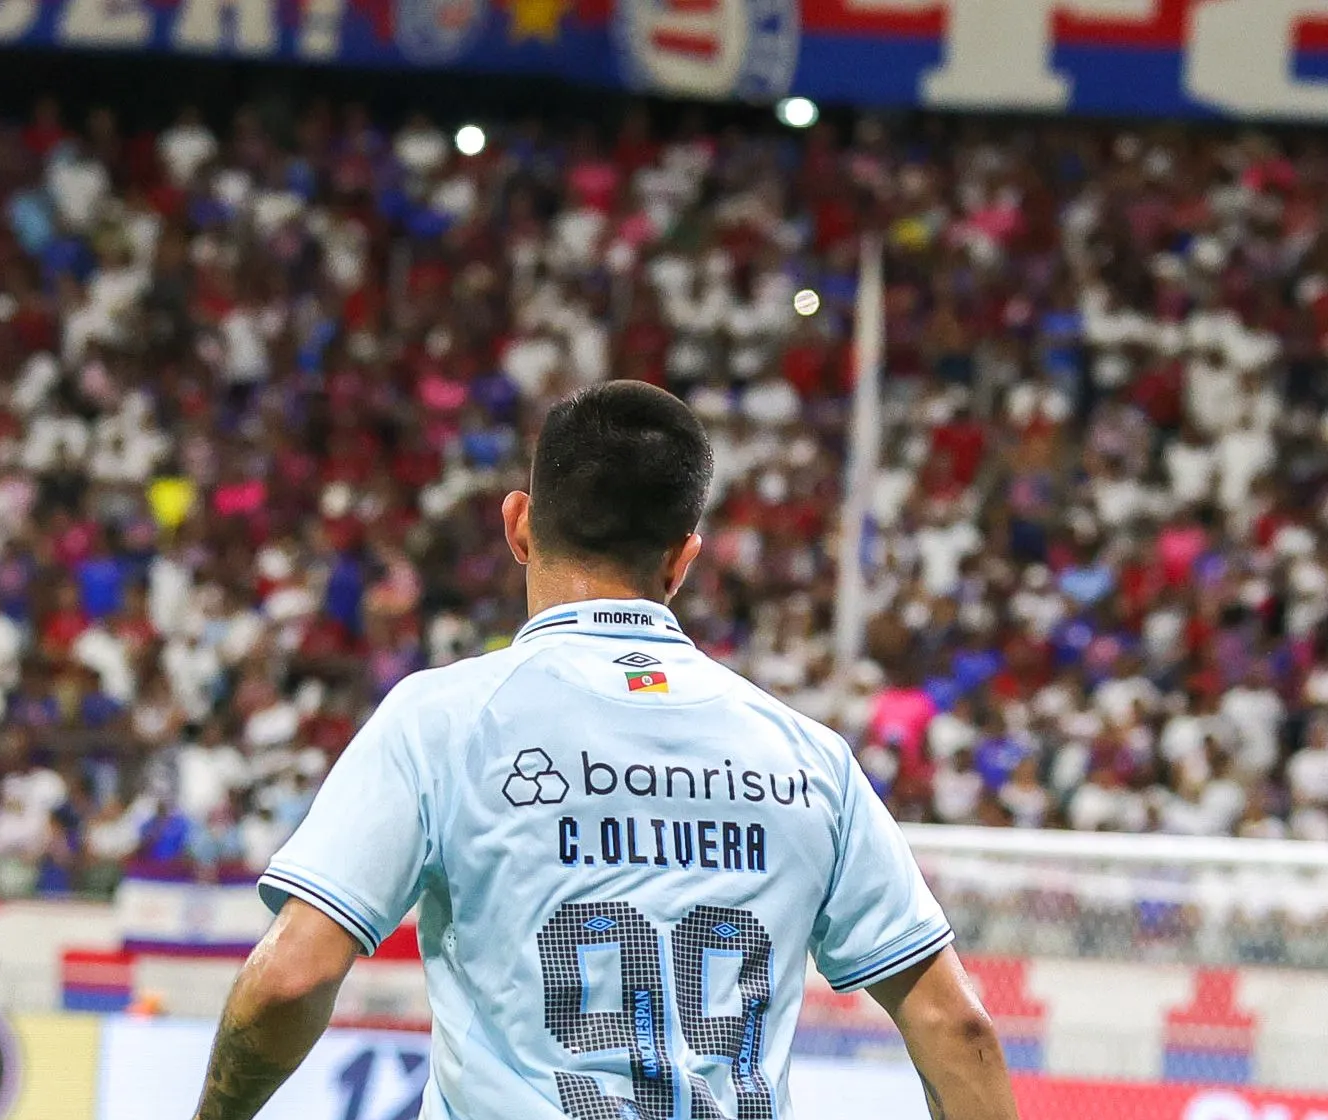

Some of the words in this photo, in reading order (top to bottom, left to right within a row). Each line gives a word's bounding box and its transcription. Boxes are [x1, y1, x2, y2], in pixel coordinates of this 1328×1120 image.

[593, 611, 655, 626] IMORTAL
[581, 750, 812, 808] banrisul
[558, 815, 768, 872] C.OLIVERA
[633, 990, 661, 1079] ARQUESPAN
